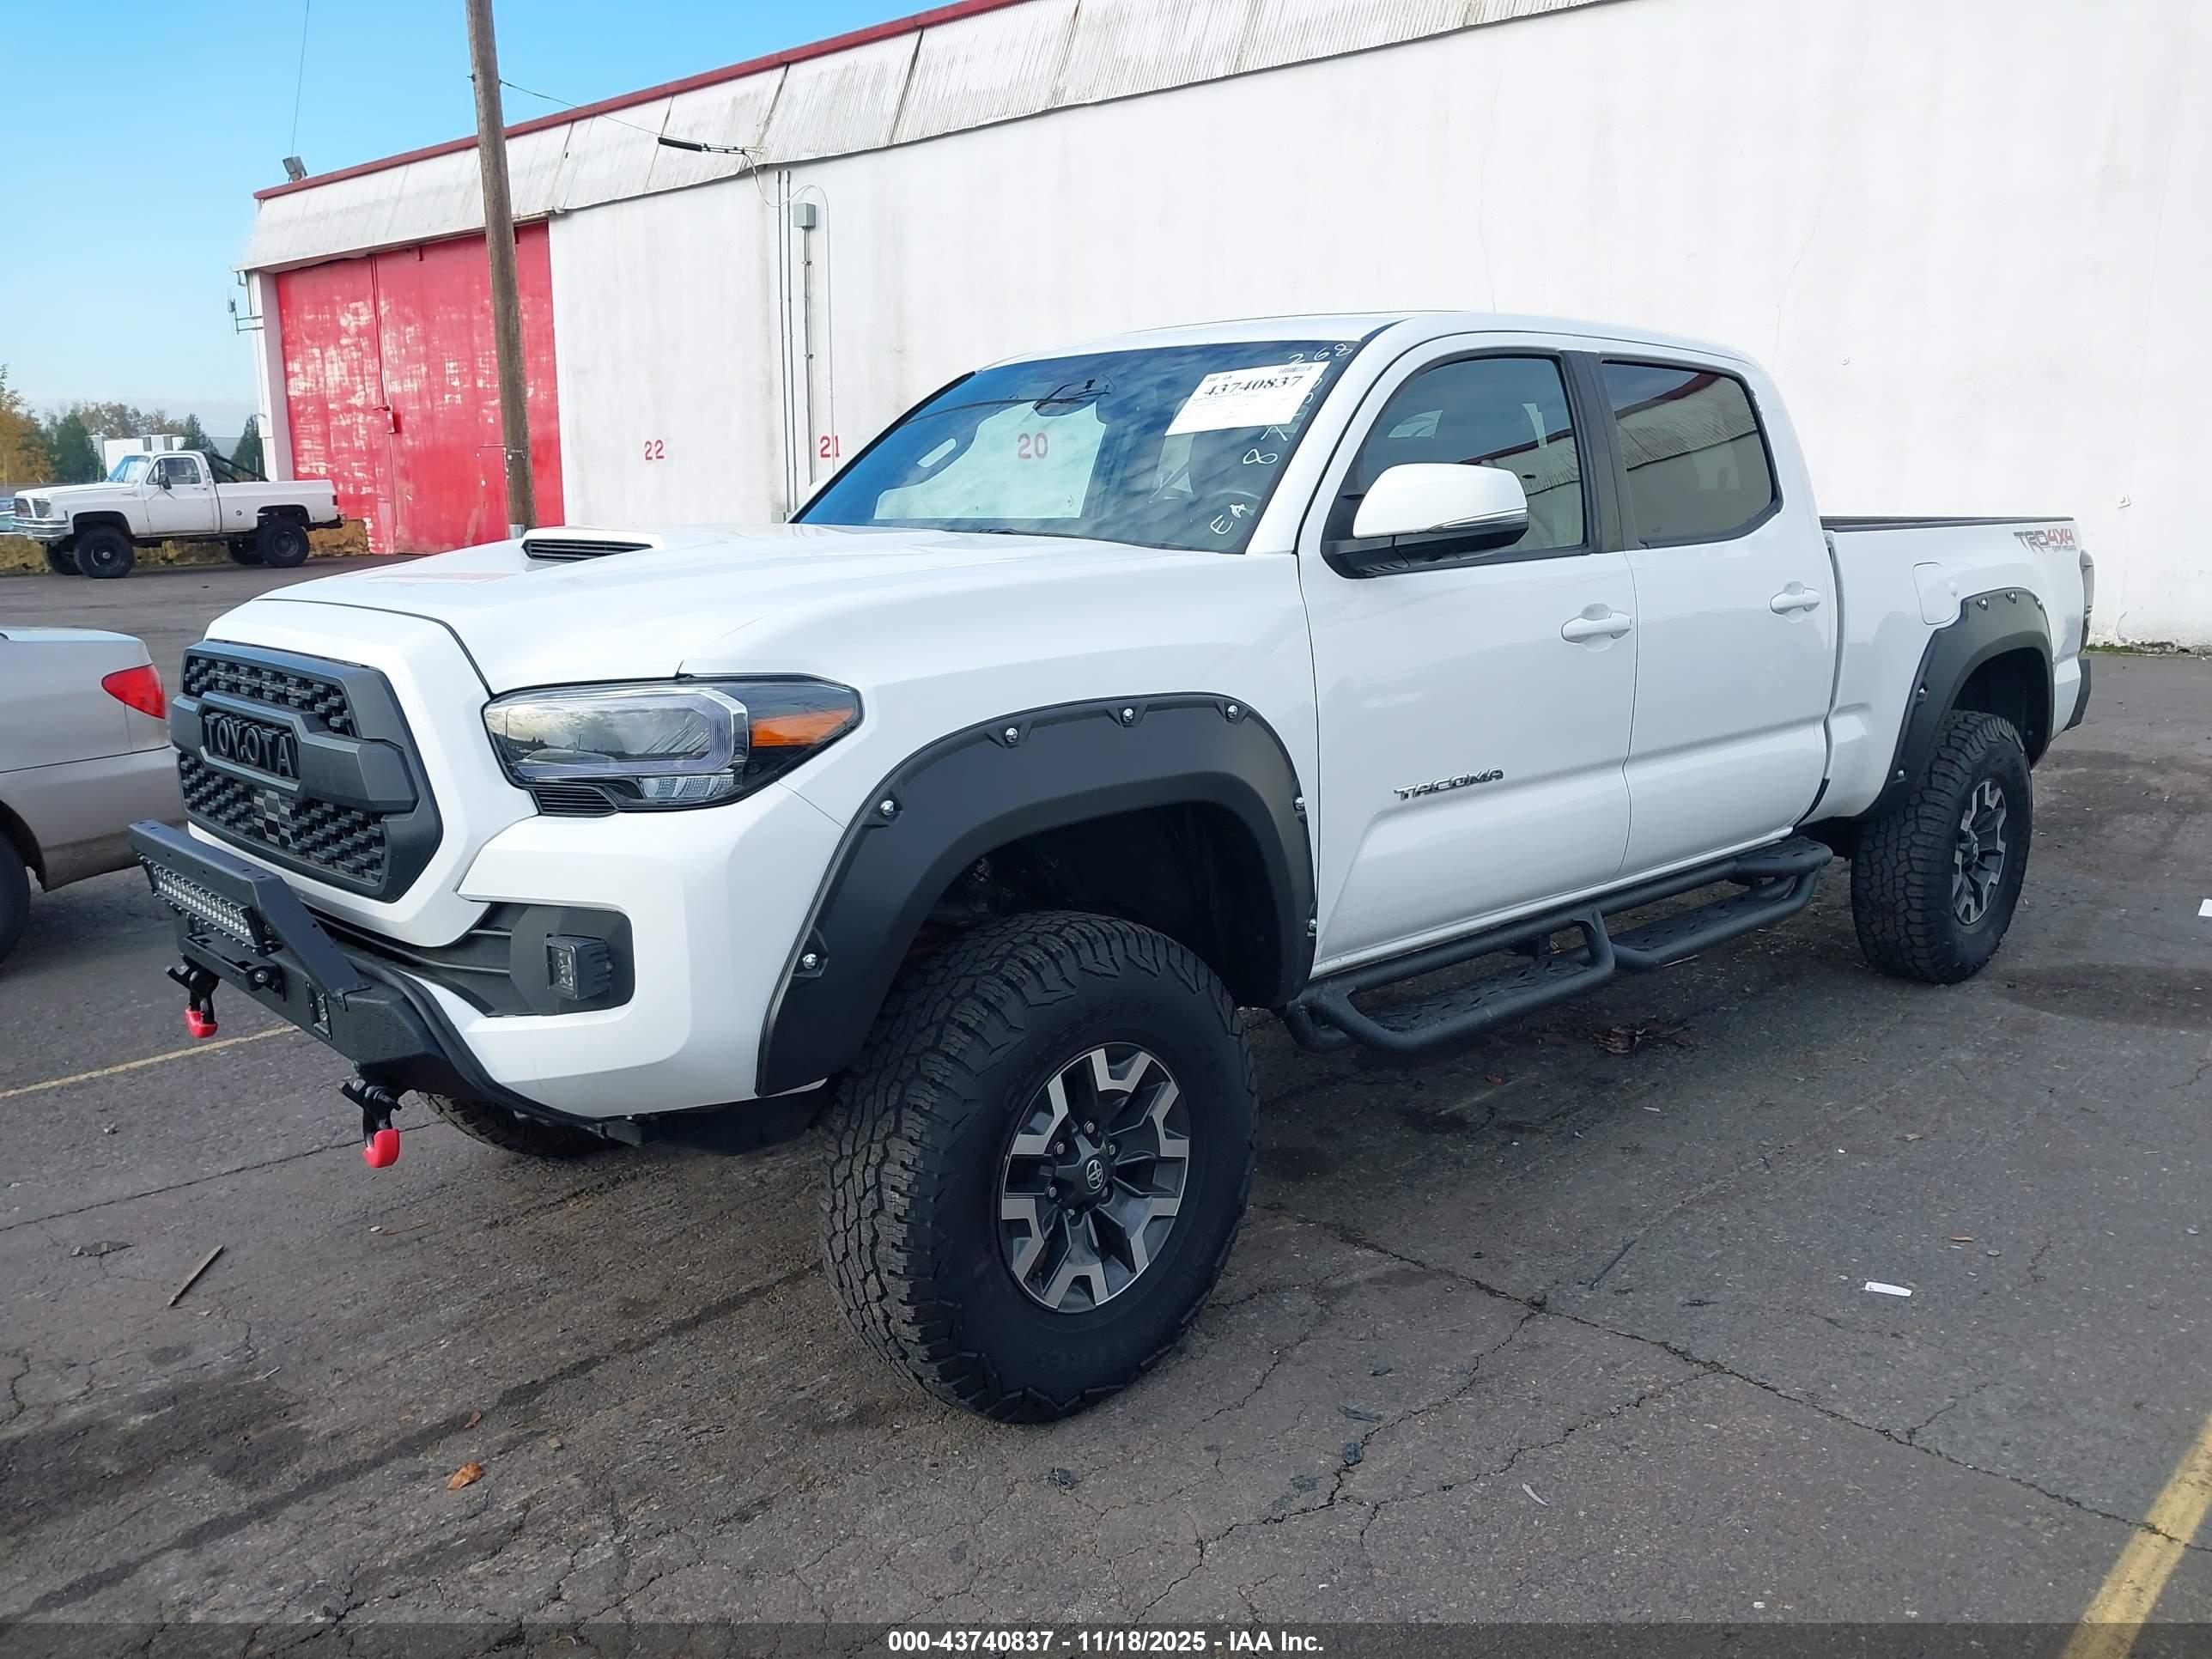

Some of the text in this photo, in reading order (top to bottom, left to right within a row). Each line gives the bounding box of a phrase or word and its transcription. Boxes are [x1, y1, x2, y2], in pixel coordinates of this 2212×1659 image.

[1204, 375, 1304, 396] 43740837
[644, 439, 665, 460] 22
[820, 435, 840, 458] 21
[1018, 432, 1048, 459] 20
[204, 714, 298, 778] TOYOTA
[1393, 768, 1504, 800] TACOMA
